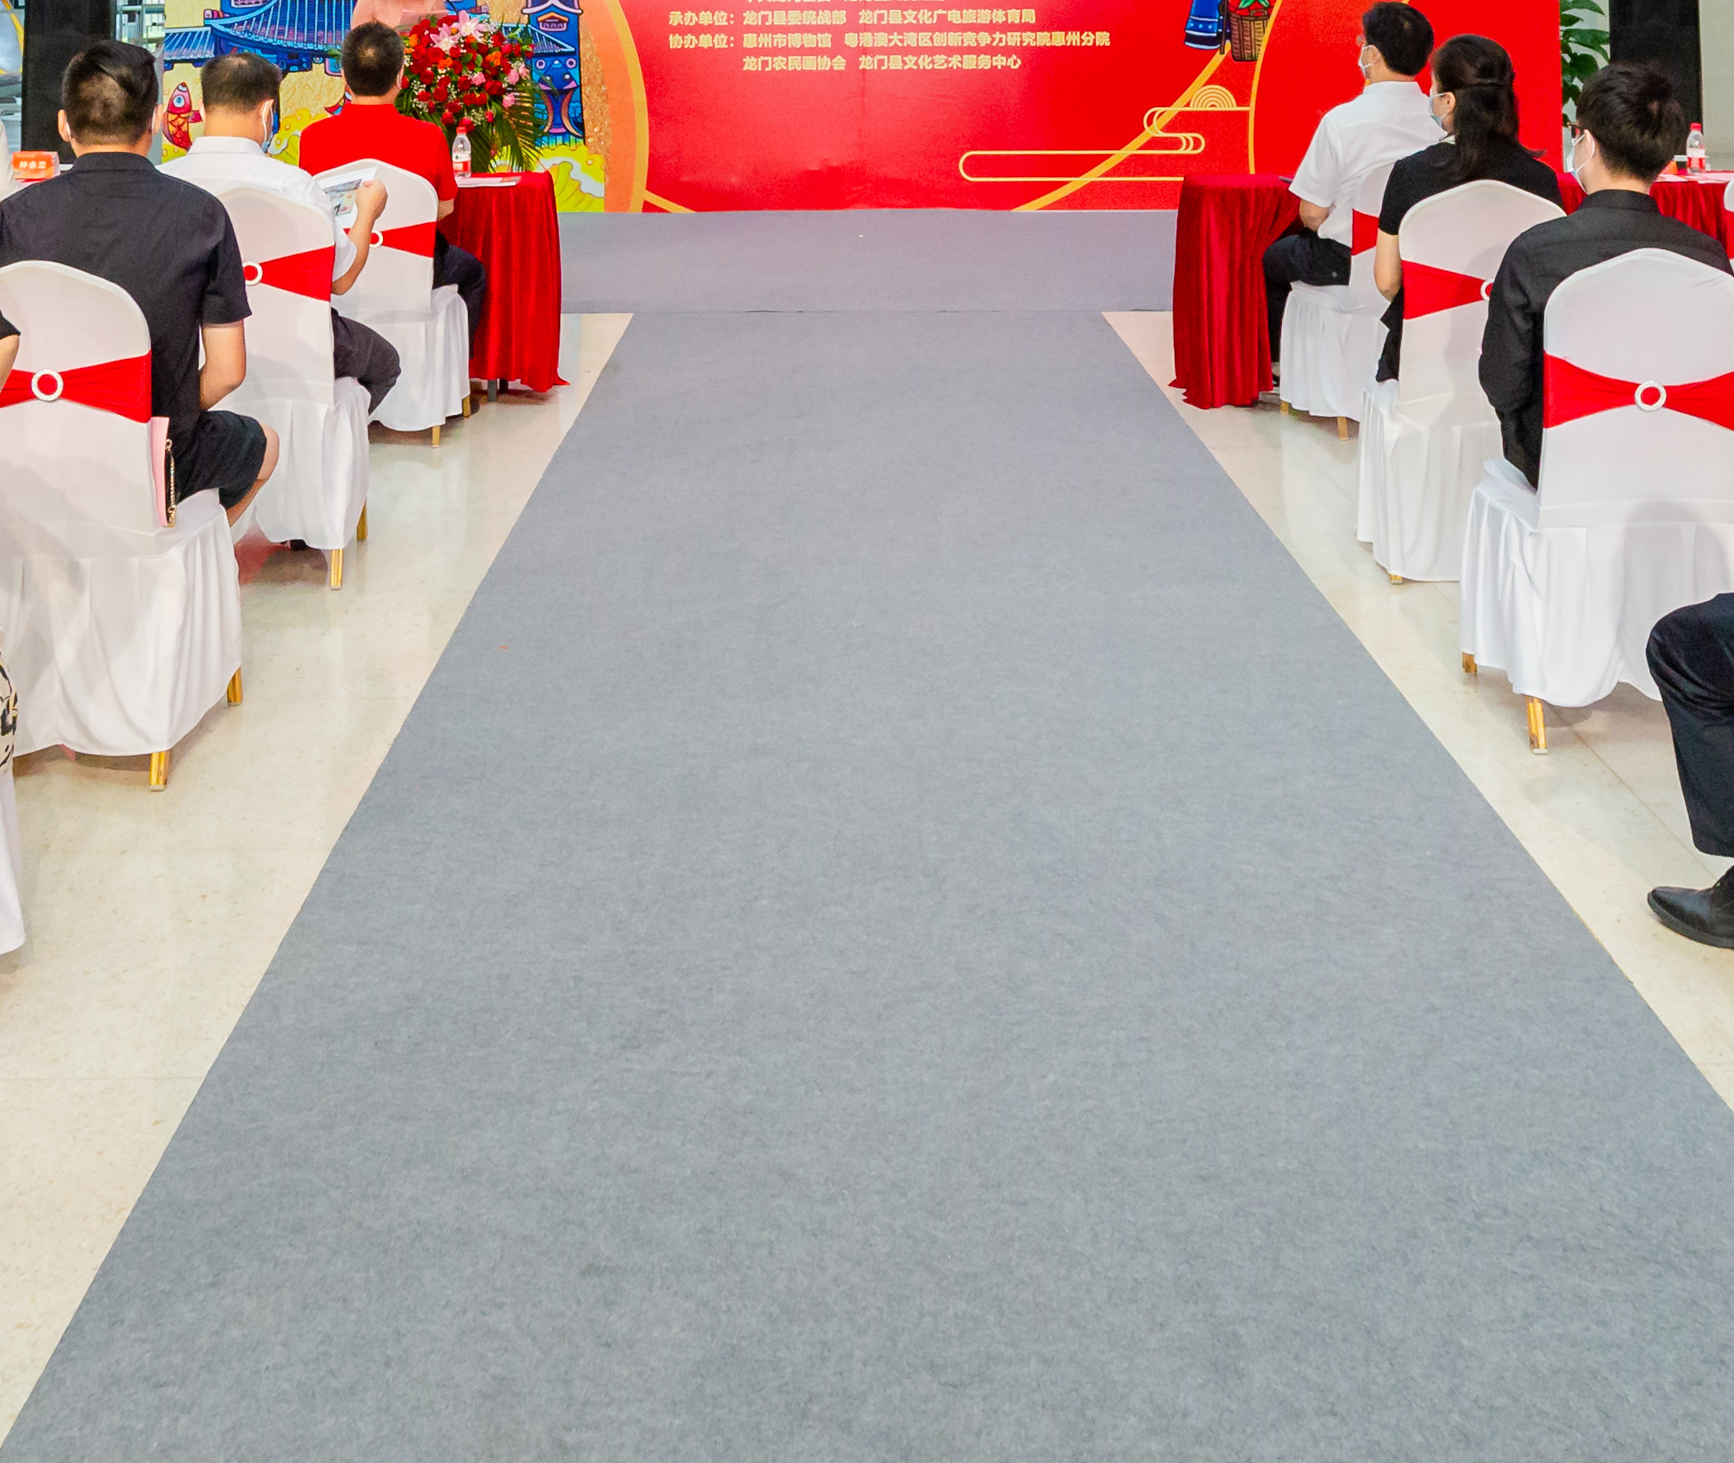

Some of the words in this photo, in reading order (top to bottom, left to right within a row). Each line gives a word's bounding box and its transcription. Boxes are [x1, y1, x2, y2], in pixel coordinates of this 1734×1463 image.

[669, 11, 735, 26] 承办单位：
[742, 10, 846, 25] 龙门县委统战部
[858, 9, 1036, 24] 龙门县文化广电旅游体育局
[669, 34, 735, 49] 协办单位：
[742, 33, 832, 48] 惠州市博物馆
[844, 32, 1111, 48] 粤港澳大湾区创新竞争力研究院惠州分院
[742, 56, 846, 71] 龙门农民画协会
[858, 54, 1022, 70] 龙门县文化艺术服务中心
